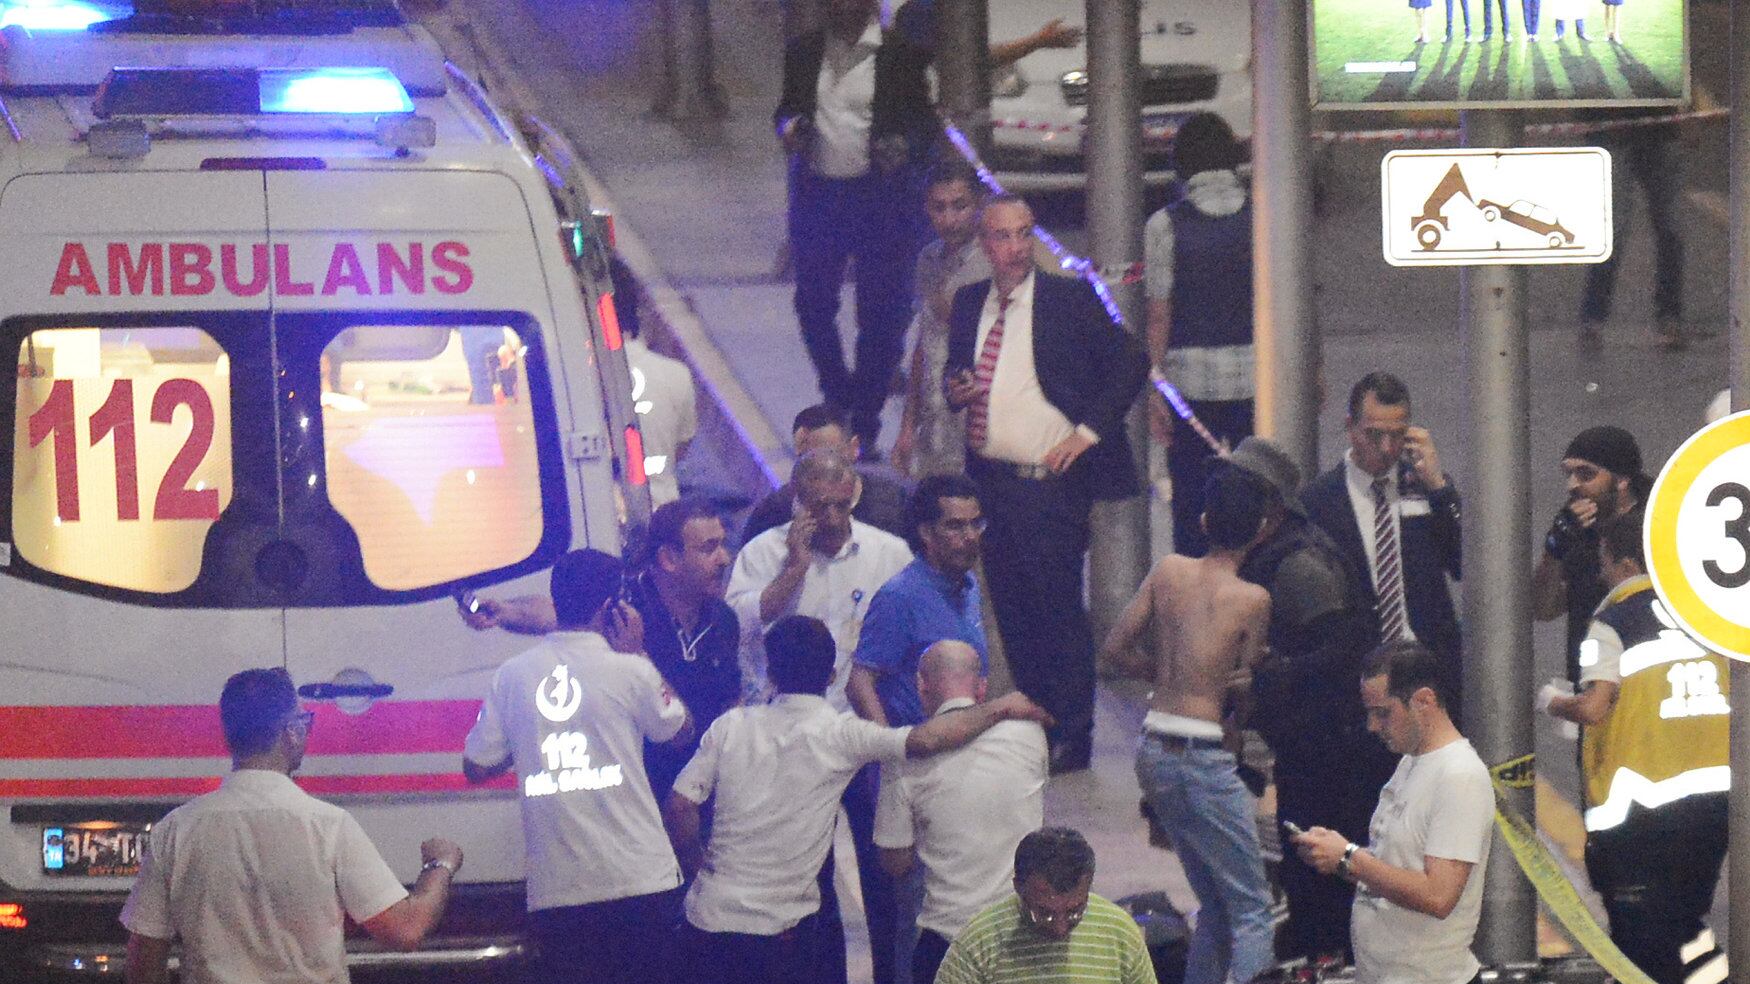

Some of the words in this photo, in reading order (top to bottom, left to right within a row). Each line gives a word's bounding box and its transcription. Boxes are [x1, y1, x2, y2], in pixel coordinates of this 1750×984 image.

[50, 241, 474, 296] AMBULANS
[29, 378, 221, 522] 112
[541, 731, 591, 771] 112
